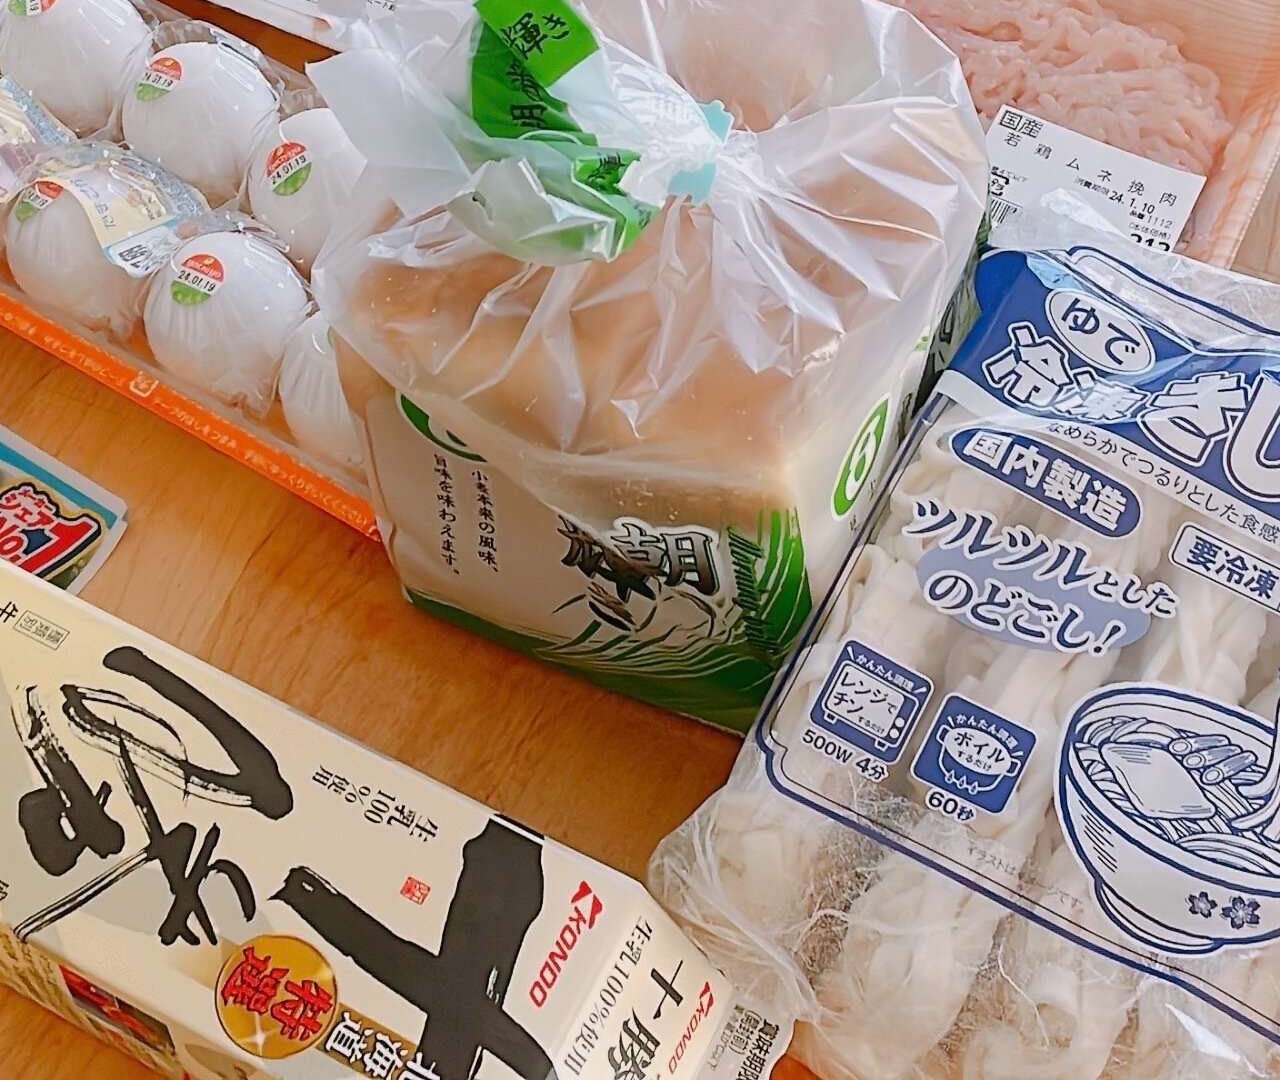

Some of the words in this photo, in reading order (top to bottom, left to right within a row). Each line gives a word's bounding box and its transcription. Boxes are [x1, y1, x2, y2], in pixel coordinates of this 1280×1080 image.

[999, 110, 1044, 140] 国産
[269, 154, 308, 186] 24.01.19
[177, 268, 219, 295] 24.01.19
[1058, 294, 1140, 370] ゆで
[980, 323, 1151, 424] 冷凍
[961, 433, 1126, 531] 国内製造
[470, 468, 501, 575] 小麦本来の風味、
[907, 496, 1179, 618] ツルツルとした
[1182, 537, 1278, 602] 要冷凍
[926, 570, 1120, 657] のどごし!
[840, 671, 897, 714] レンジで
[802, 728, 854, 765] 500W
[855, 756, 887, 782] 4分
[953, 730, 1006, 765] ボイル
[311, 766, 440, 844] 生乳100%使用
[928, 790, 975, 822] 60秒
[220, 946, 334, 1042] 特選
[528, 907, 597, 1009] KONDO
[564, 916, 655, 1076] 生乳100%使用
[667, 1000, 714, 1075] KONDO
